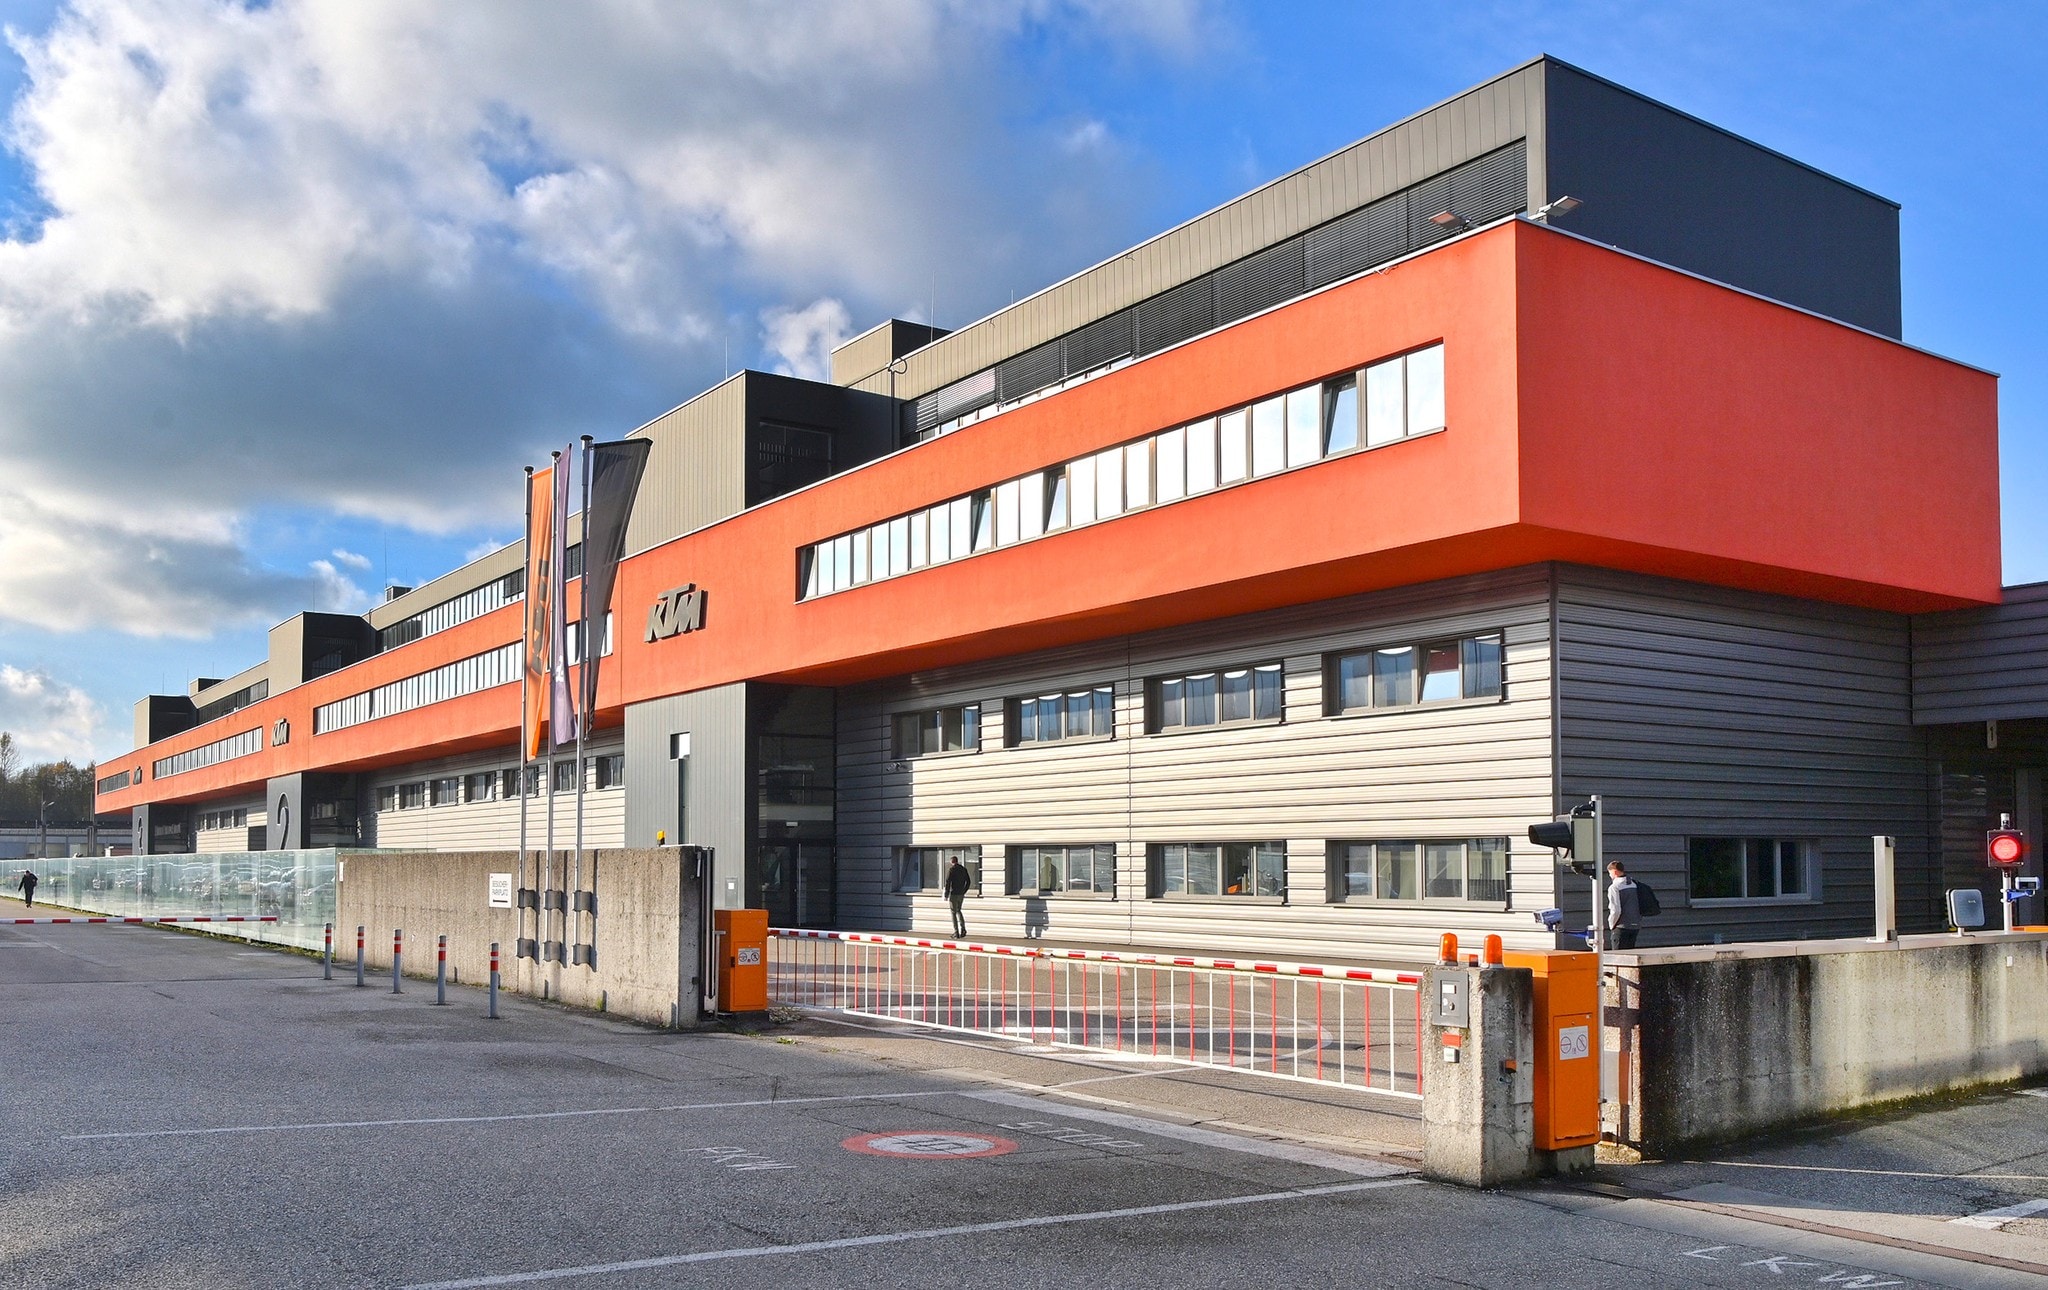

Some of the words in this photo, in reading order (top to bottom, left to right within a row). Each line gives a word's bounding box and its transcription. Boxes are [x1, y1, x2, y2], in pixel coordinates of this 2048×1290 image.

[644, 583, 704, 642] KTM
[271, 718, 288, 746] KTM
[997, 1121, 1144, 1148] STOP
[1683, 1245, 1904, 1289] LKW
